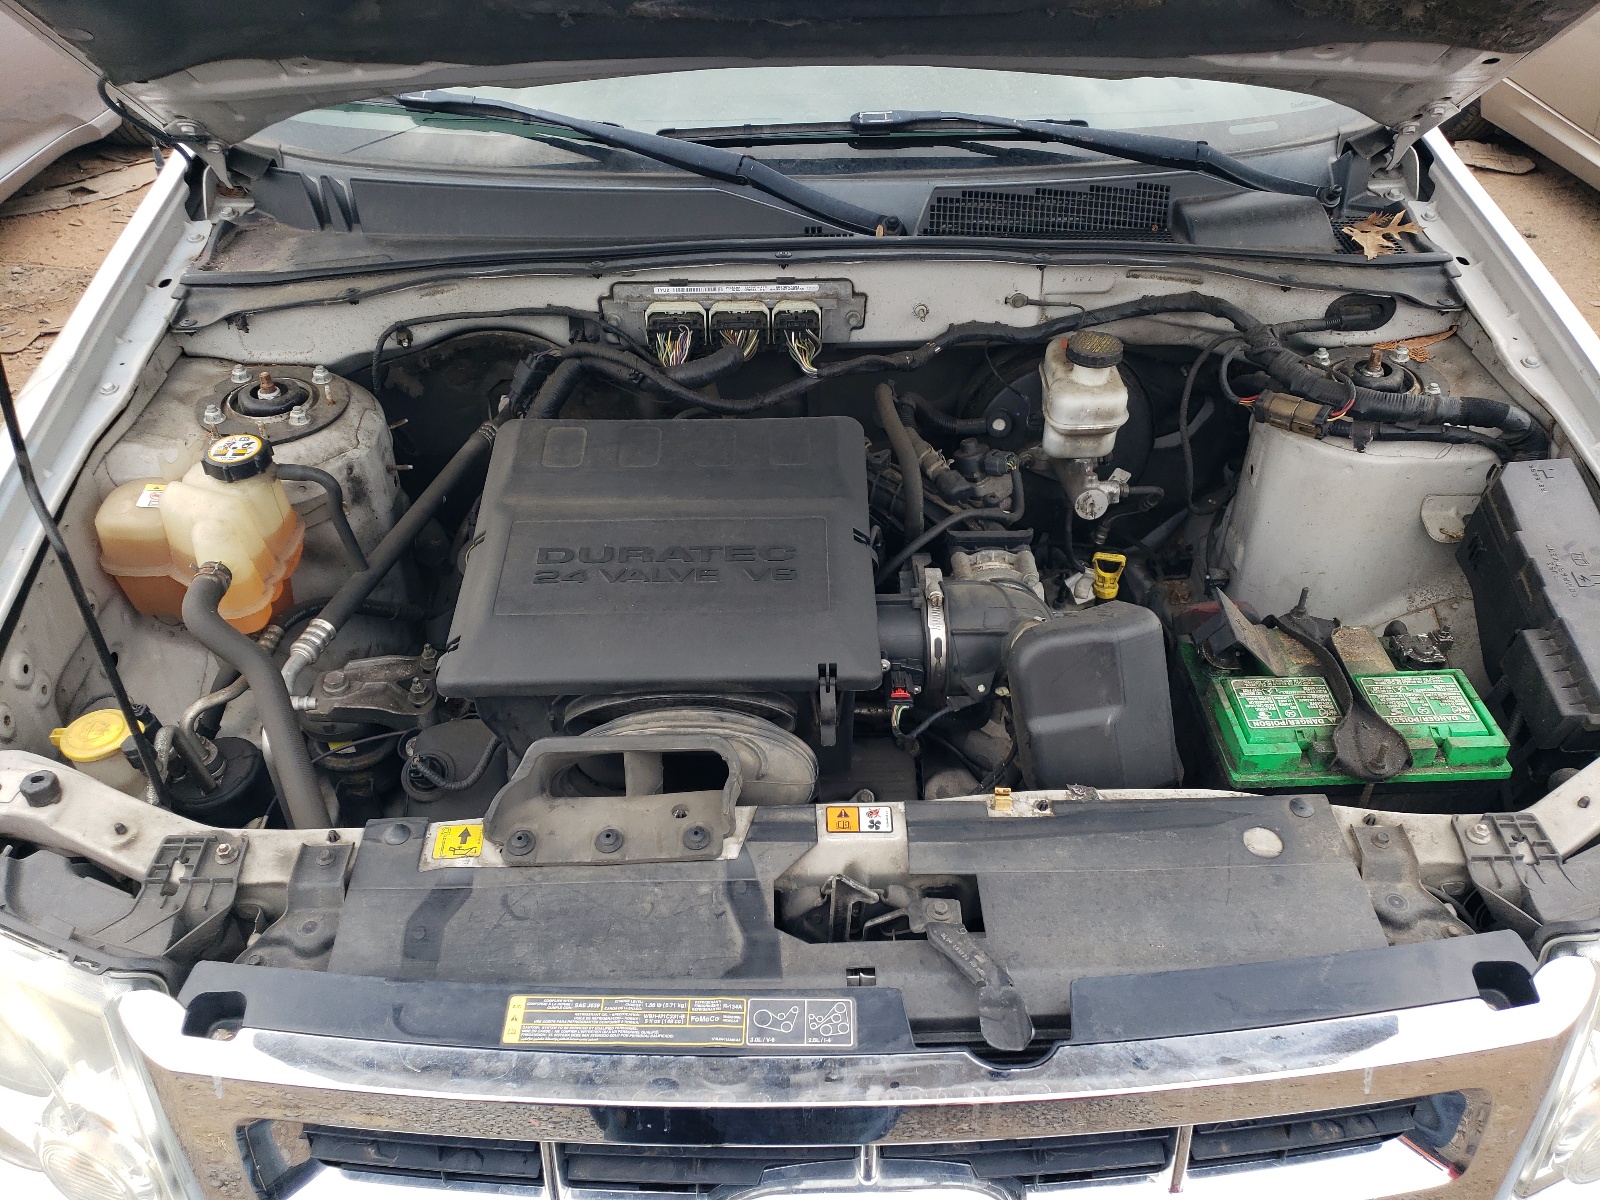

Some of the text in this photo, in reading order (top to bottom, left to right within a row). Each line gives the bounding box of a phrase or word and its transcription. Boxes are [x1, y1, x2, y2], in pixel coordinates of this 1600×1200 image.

[536, 545, 797, 565] DURATEC
[533, 567, 797, 585] 24 VALVE V6
[1252, 718, 1325, 727] DANGER/POISON
[1386, 715, 1458, 724] DANGER/POISON
[690, 1015, 720, 1023] FoMoCo
